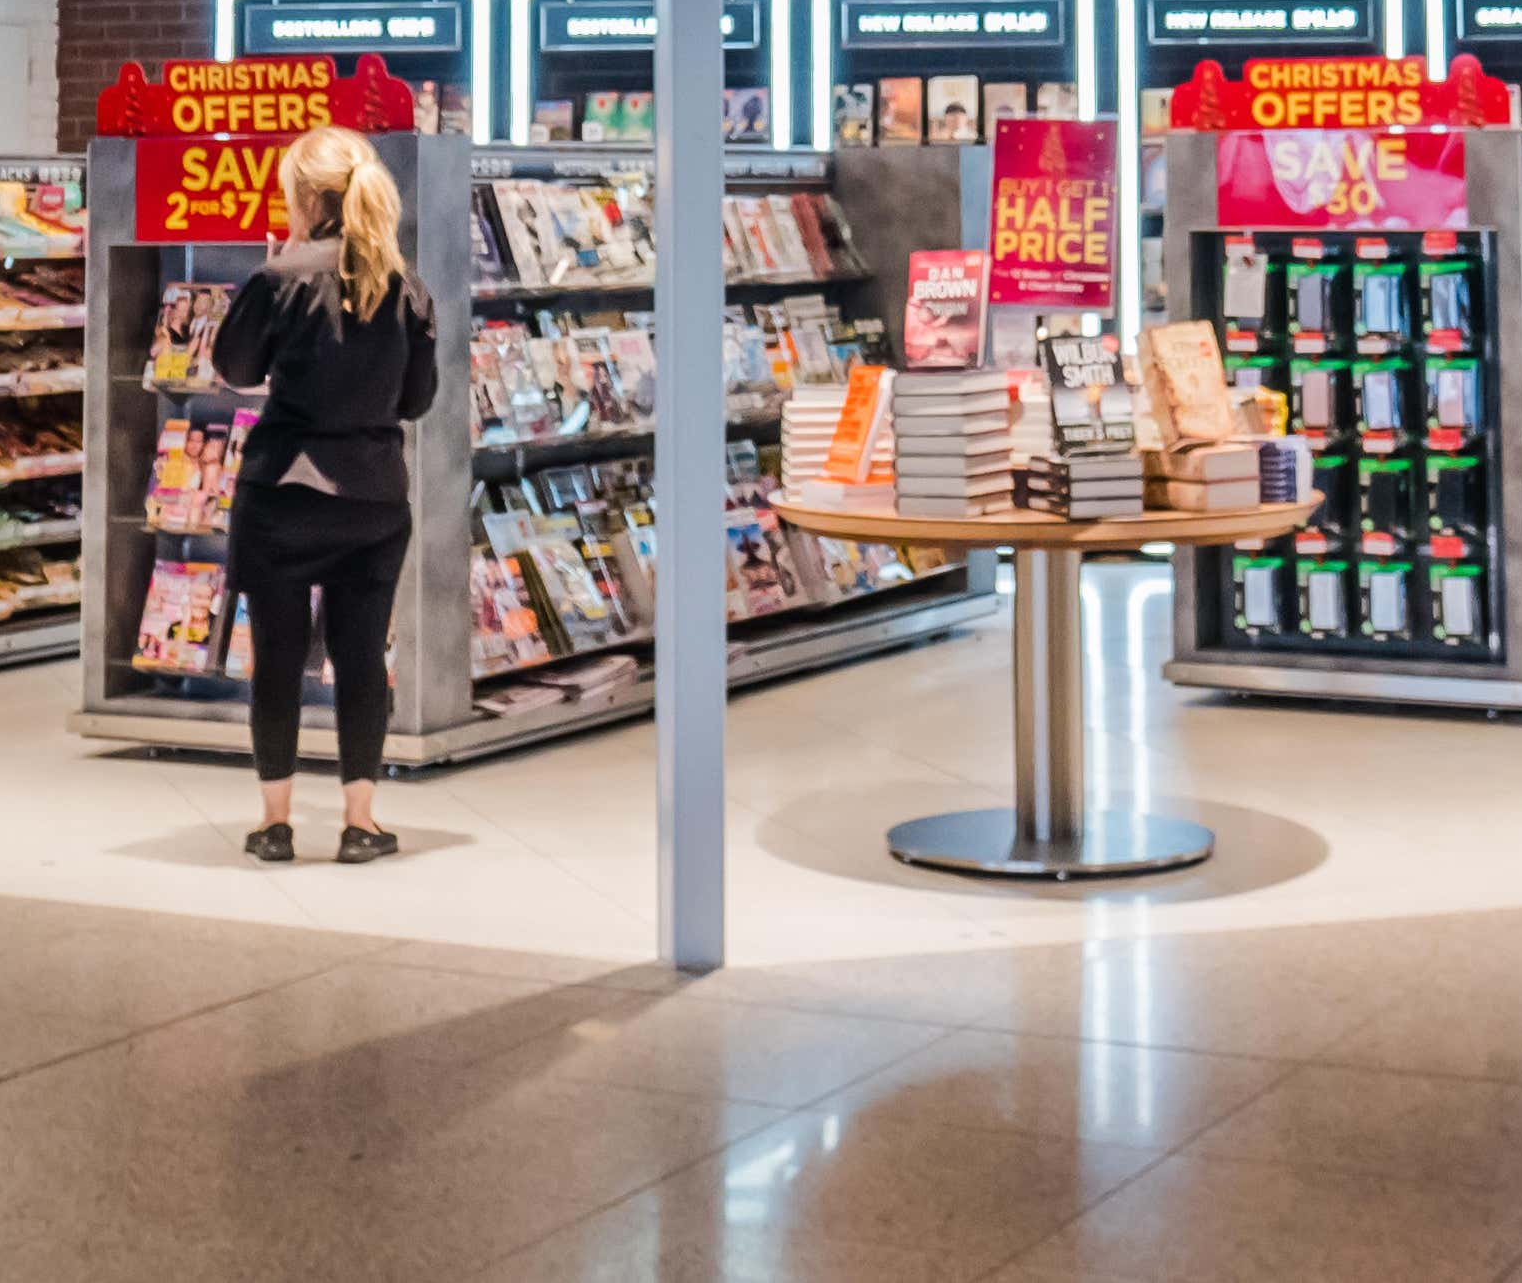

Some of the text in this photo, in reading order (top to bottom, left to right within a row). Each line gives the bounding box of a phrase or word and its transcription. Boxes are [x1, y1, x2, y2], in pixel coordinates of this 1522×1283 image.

[169, 62, 330, 91] CHRISTMAS
[1250, 62, 1421, 89] CHRISTMAS
[172, 94, 332, 134] OFFERS
[1251, 91, 1423, 127] OFFERS
[182, 147, 287, 191] SAV
[1276, 139, 1407, 180] SAVE
[999, 178, 1041, 197] BUY
[1057, 180, 1097, 197] GET
[165, 192, 188, 229] 2
[190, 201, 220, 215] FOR
[222, 190, 262, 229] $7
[997, 196, 1110, 232] HALF
[995, 230, 1108, 265] PRICE
[914, 279, 978, 300] BROWN
[928, 267, 965, 281] DAN
[1062, 364, 1115, 388] SMITH
